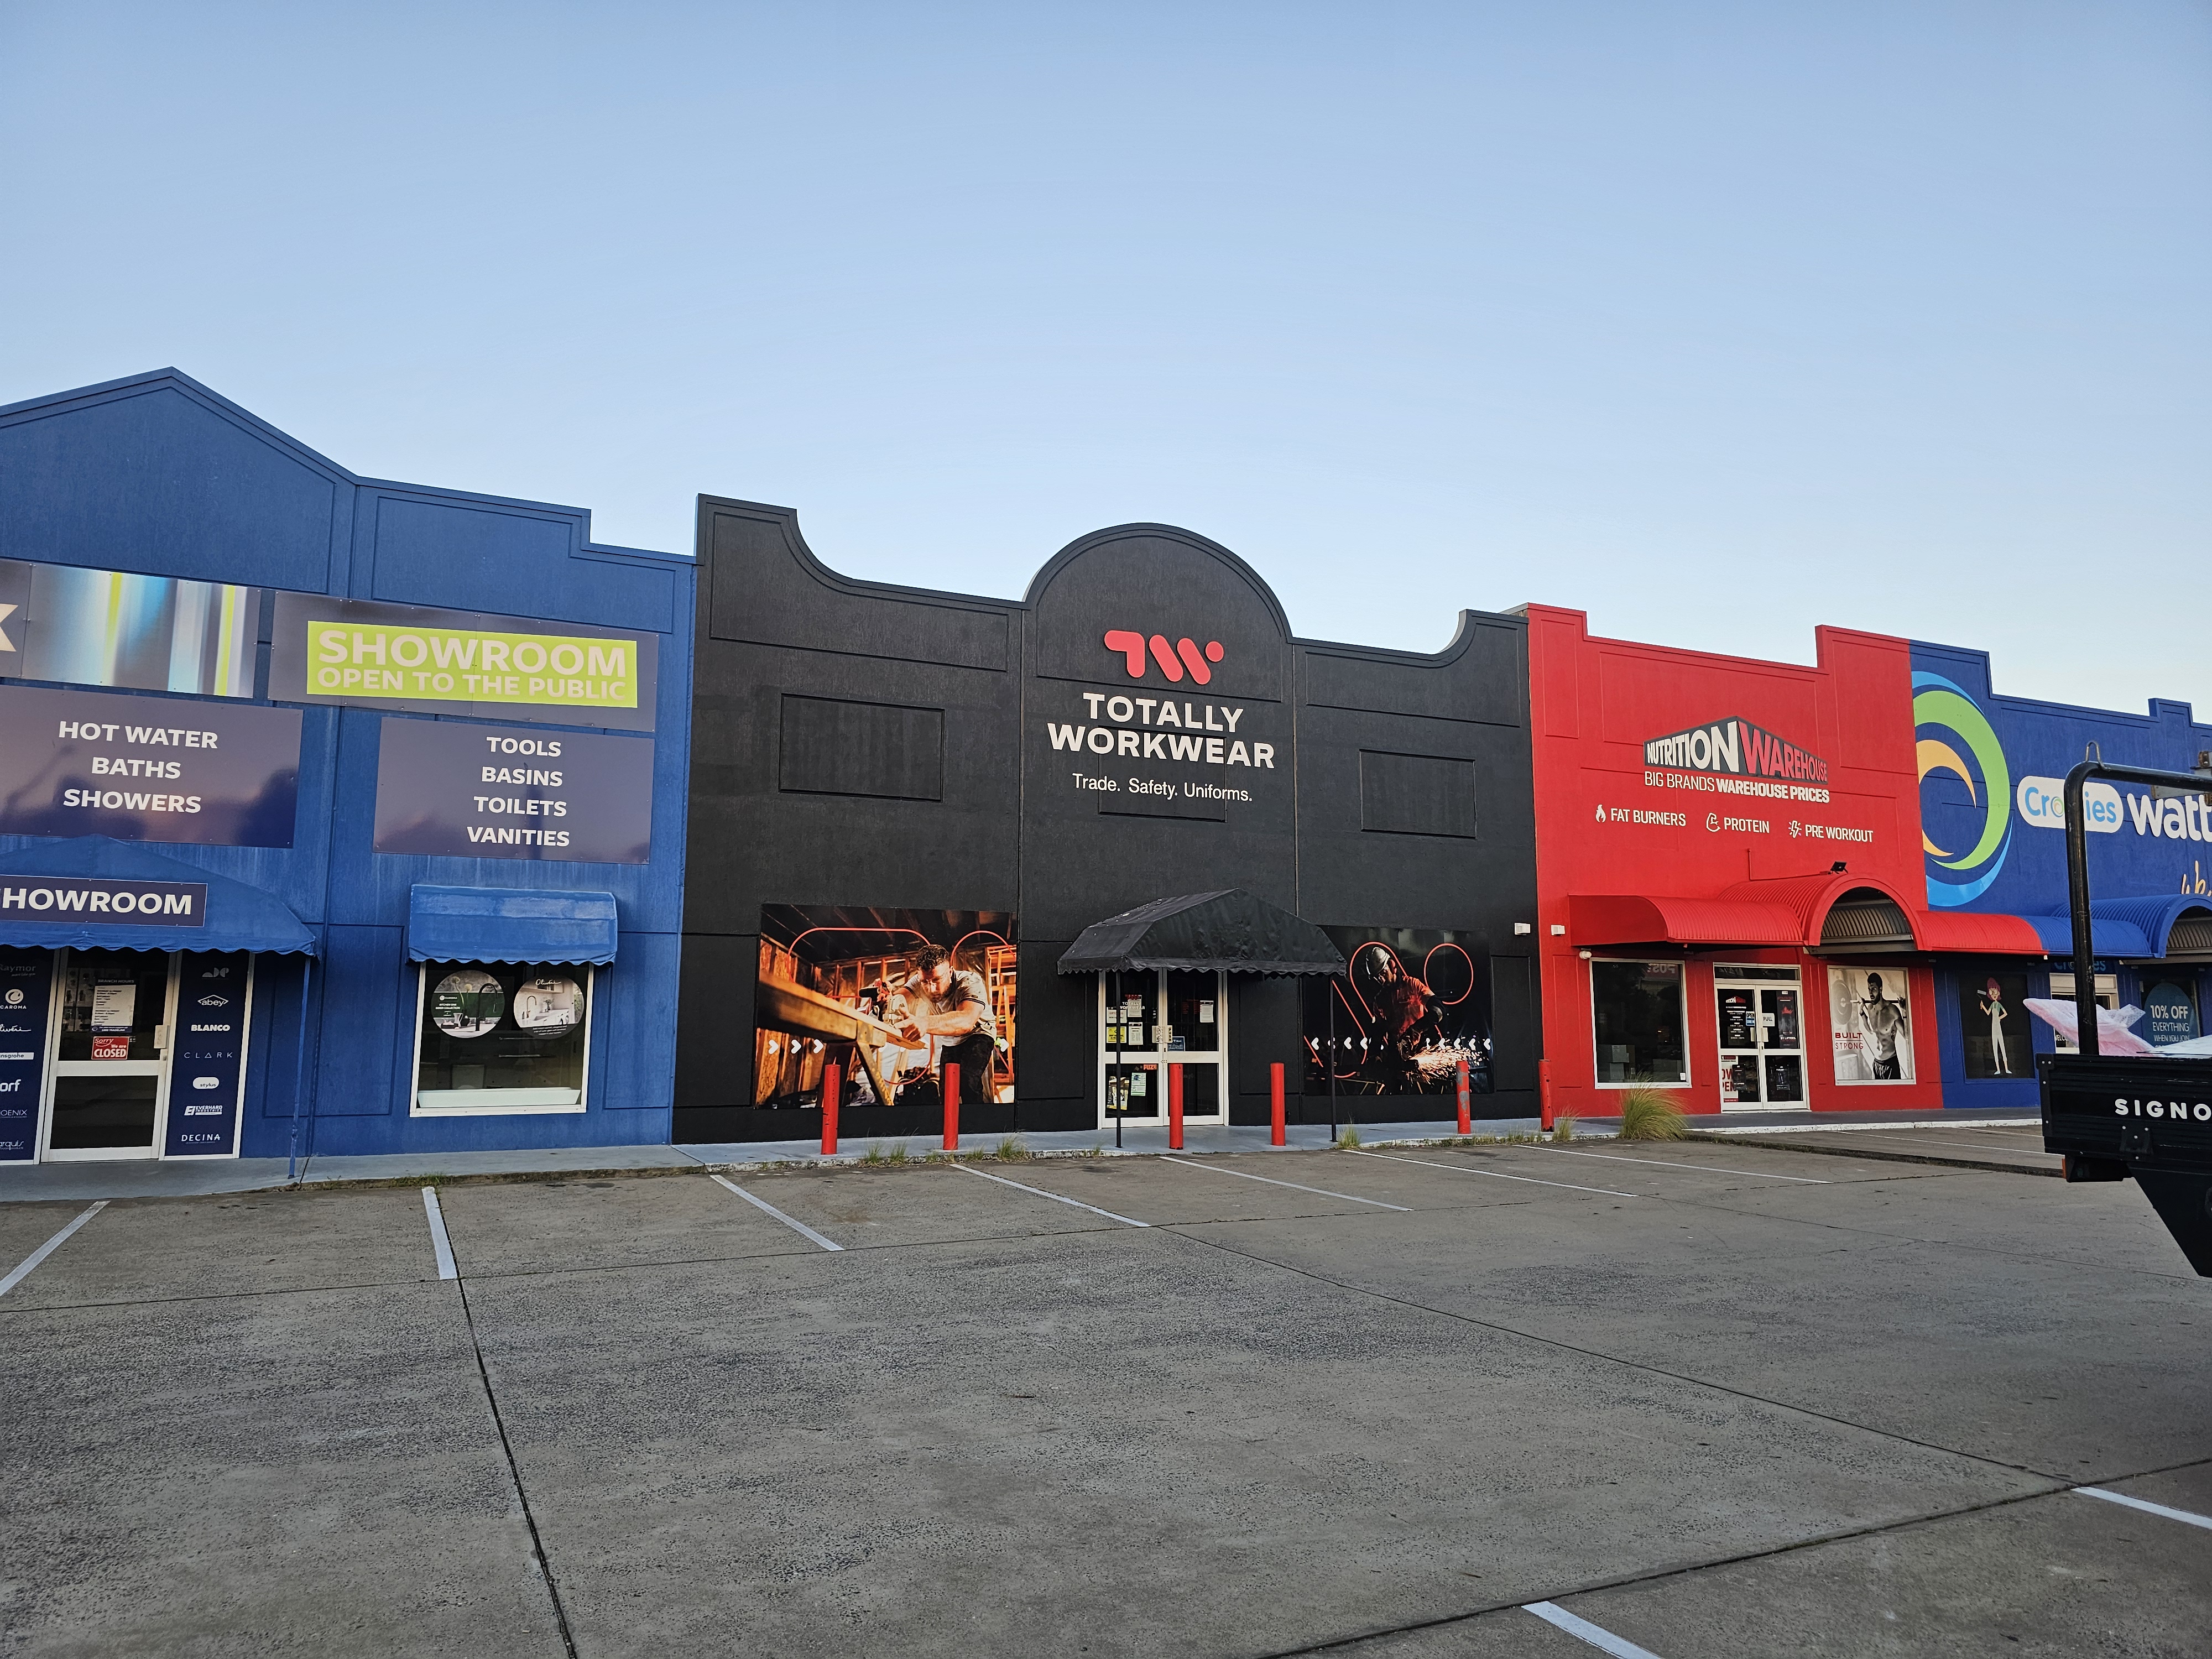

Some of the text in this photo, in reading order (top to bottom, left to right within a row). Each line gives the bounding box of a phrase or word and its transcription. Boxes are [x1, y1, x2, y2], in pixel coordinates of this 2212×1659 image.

[319, 630, 626, 677] SHOWROOM
[317, 667, 625, 700] OPEN TO THE PUBLIC
[1083, 692, 1244, 732] TOTALLY
[58, 721, 218, 749] HOT WATER
[1047, 723, 1275, 769] WORKWEAR
[486, 737, 561, 757] TOOLS
[1646, 721, 1828, 782] NUTRITION WAREHOUSE
[91, 757, 181, 779] BATHS
[481, 766, 563, 787] BASINS
[1072, 773, 1253, 802] Trade. Safety. Uniforms.
[1645, 771, 1830, 803] BIG BRANDS WAREHOUSE PRICES
[63, 789, 201, 813] SHOWERS
[473, 796, 566, 817] TOILETS
[2025, 786, 2116, 823] Croies
[1610, 808, 1686, 827] FAT BURNERS
[1724, 817, 1770, 833] PROTEIN
[467, 827, 570, 847] VANITIES
[1805, 825, 1874, 843] PRE WORKOUT
[0, 888, 192, 915] HOWROOM
[2150, 1005, 2188, 1019] 10% OFF
[2152, 1022, 2189, 1032] EVERYTHING
[94, 1048, 127, 1058] CLOSED
[2115, 1098, 2212, 1121] SIGNO
